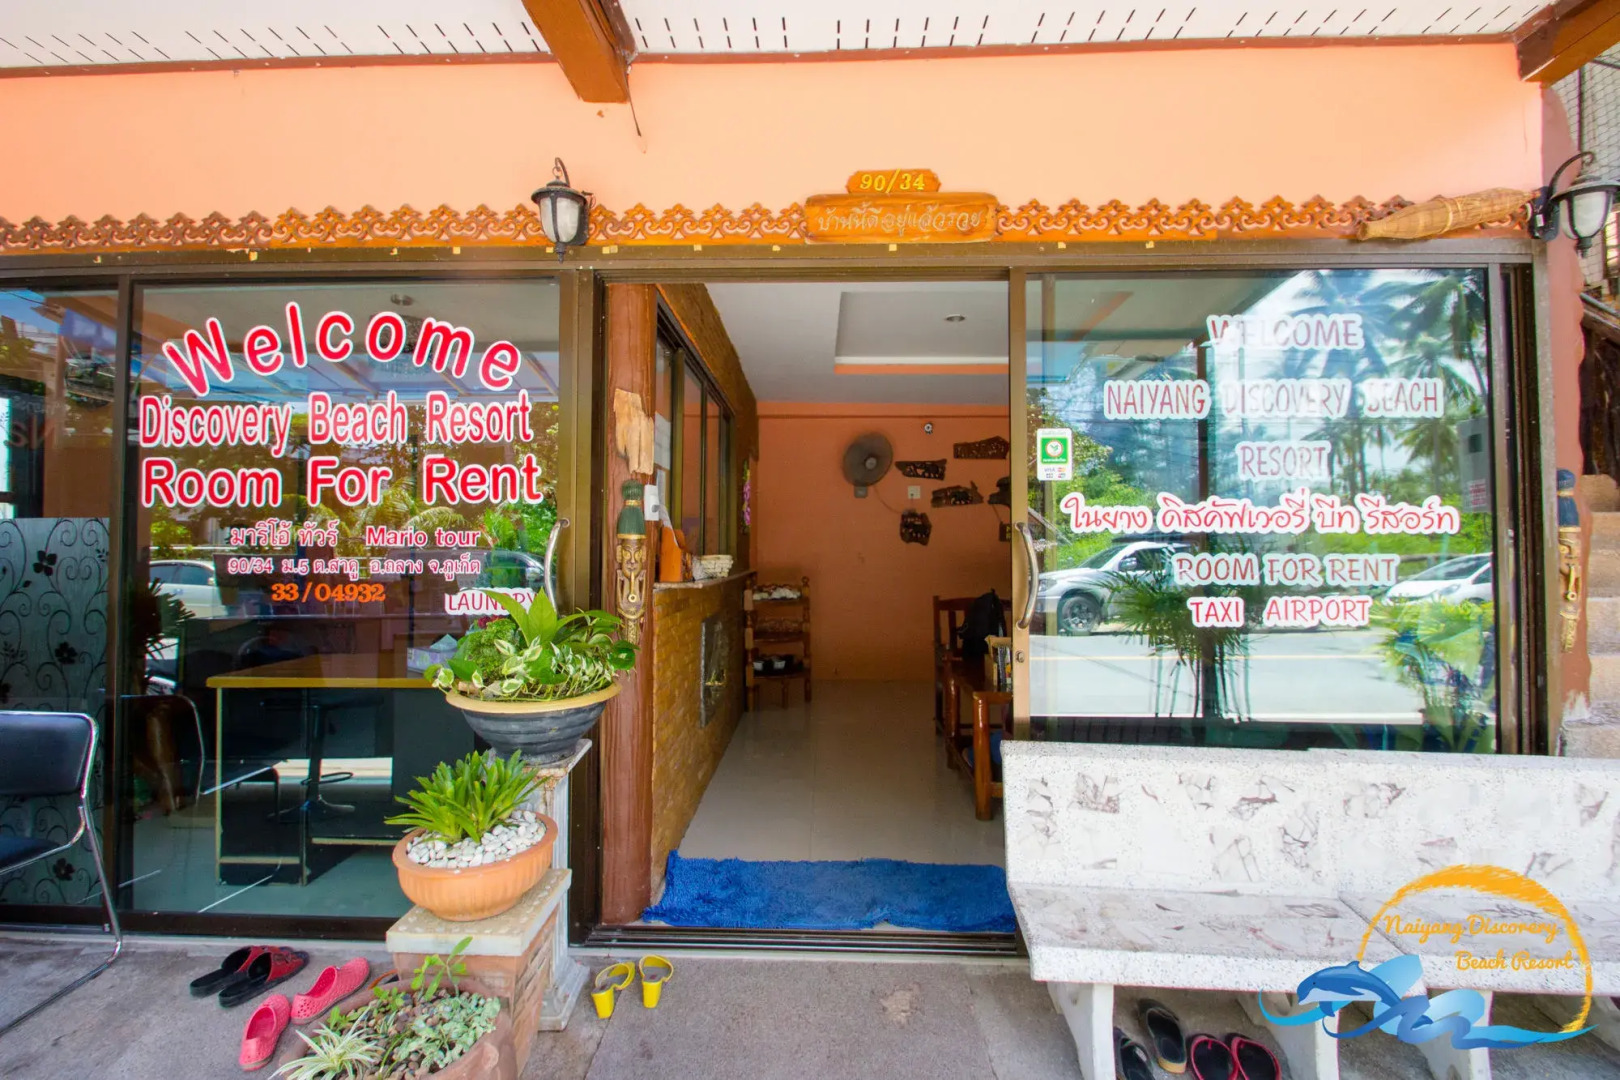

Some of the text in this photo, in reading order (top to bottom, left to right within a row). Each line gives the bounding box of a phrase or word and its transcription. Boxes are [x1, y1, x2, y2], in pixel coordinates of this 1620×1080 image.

[859, 168, 925, 194] 90/34
[1209, 317, 1362, 348] WELCOME
[163, 301, 522, 397] Welcome
[1105, 380, 1441, 417] NAIYANG DISCOVERY BEACH
[140, 388, 534, 457] Discovery Beach Resort
[1238, 444, 1329, 478] RESORT
[142, 454, 542, 507] Room For Rent
[1062, 495, 1150, 530] ในยาง
[1358, 495, 1456, 531] รีสอร์ท
[230, 518, 340, 547] มาริโอ้ ทัวร์
[366, 525, 480, 547] Mario tour
[228, 552, 480, 581] 90/34 ม.5 ต.สาคู อ.ถลาง จ.ภูเก็ต
[1175, 556, 1397, 585] ROOM FOR RENT
[1190, 599, 1370, 624] TAXI AIRPORT
